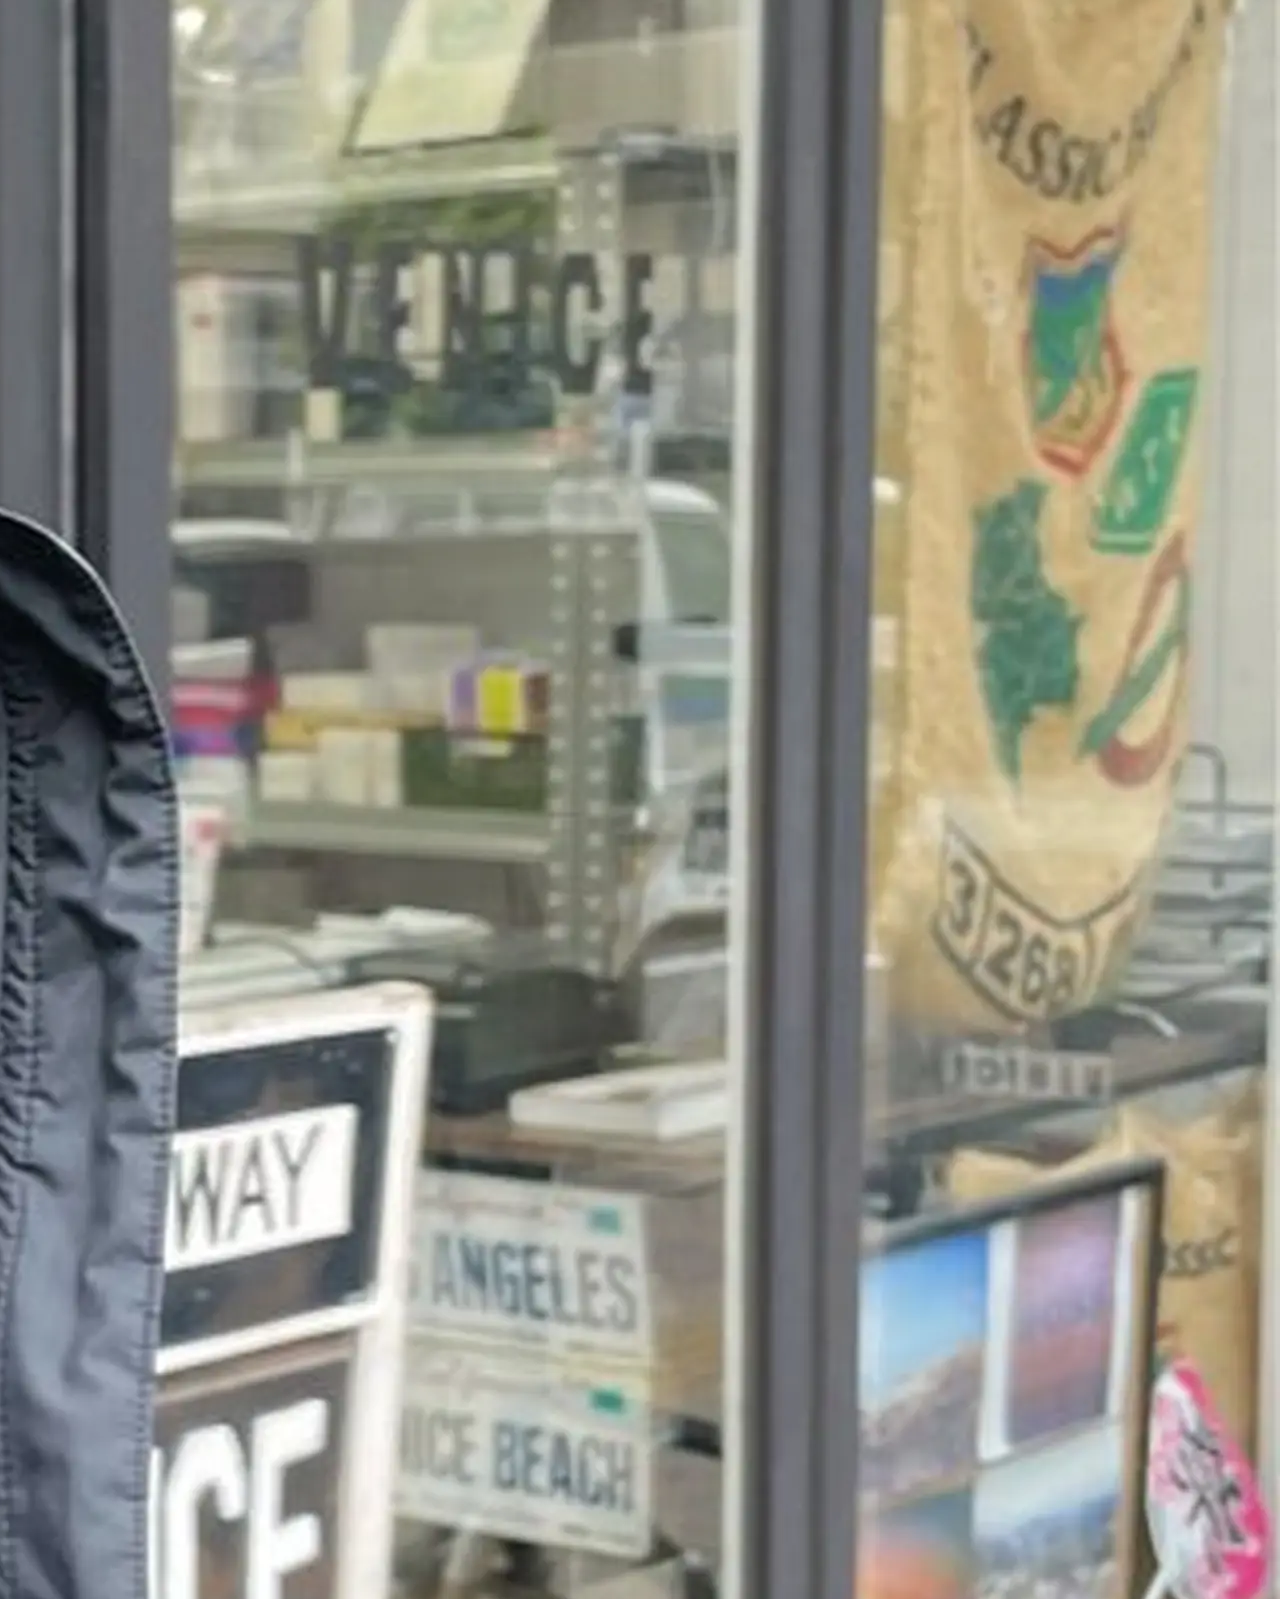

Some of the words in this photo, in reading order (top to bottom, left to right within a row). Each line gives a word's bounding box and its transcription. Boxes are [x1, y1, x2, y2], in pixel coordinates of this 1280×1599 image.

[171, 1119, 327, 1255] WAY
[431, 1231, 638, 1335] ANGELES
[493, 1418, 634, 1517] BEACH
